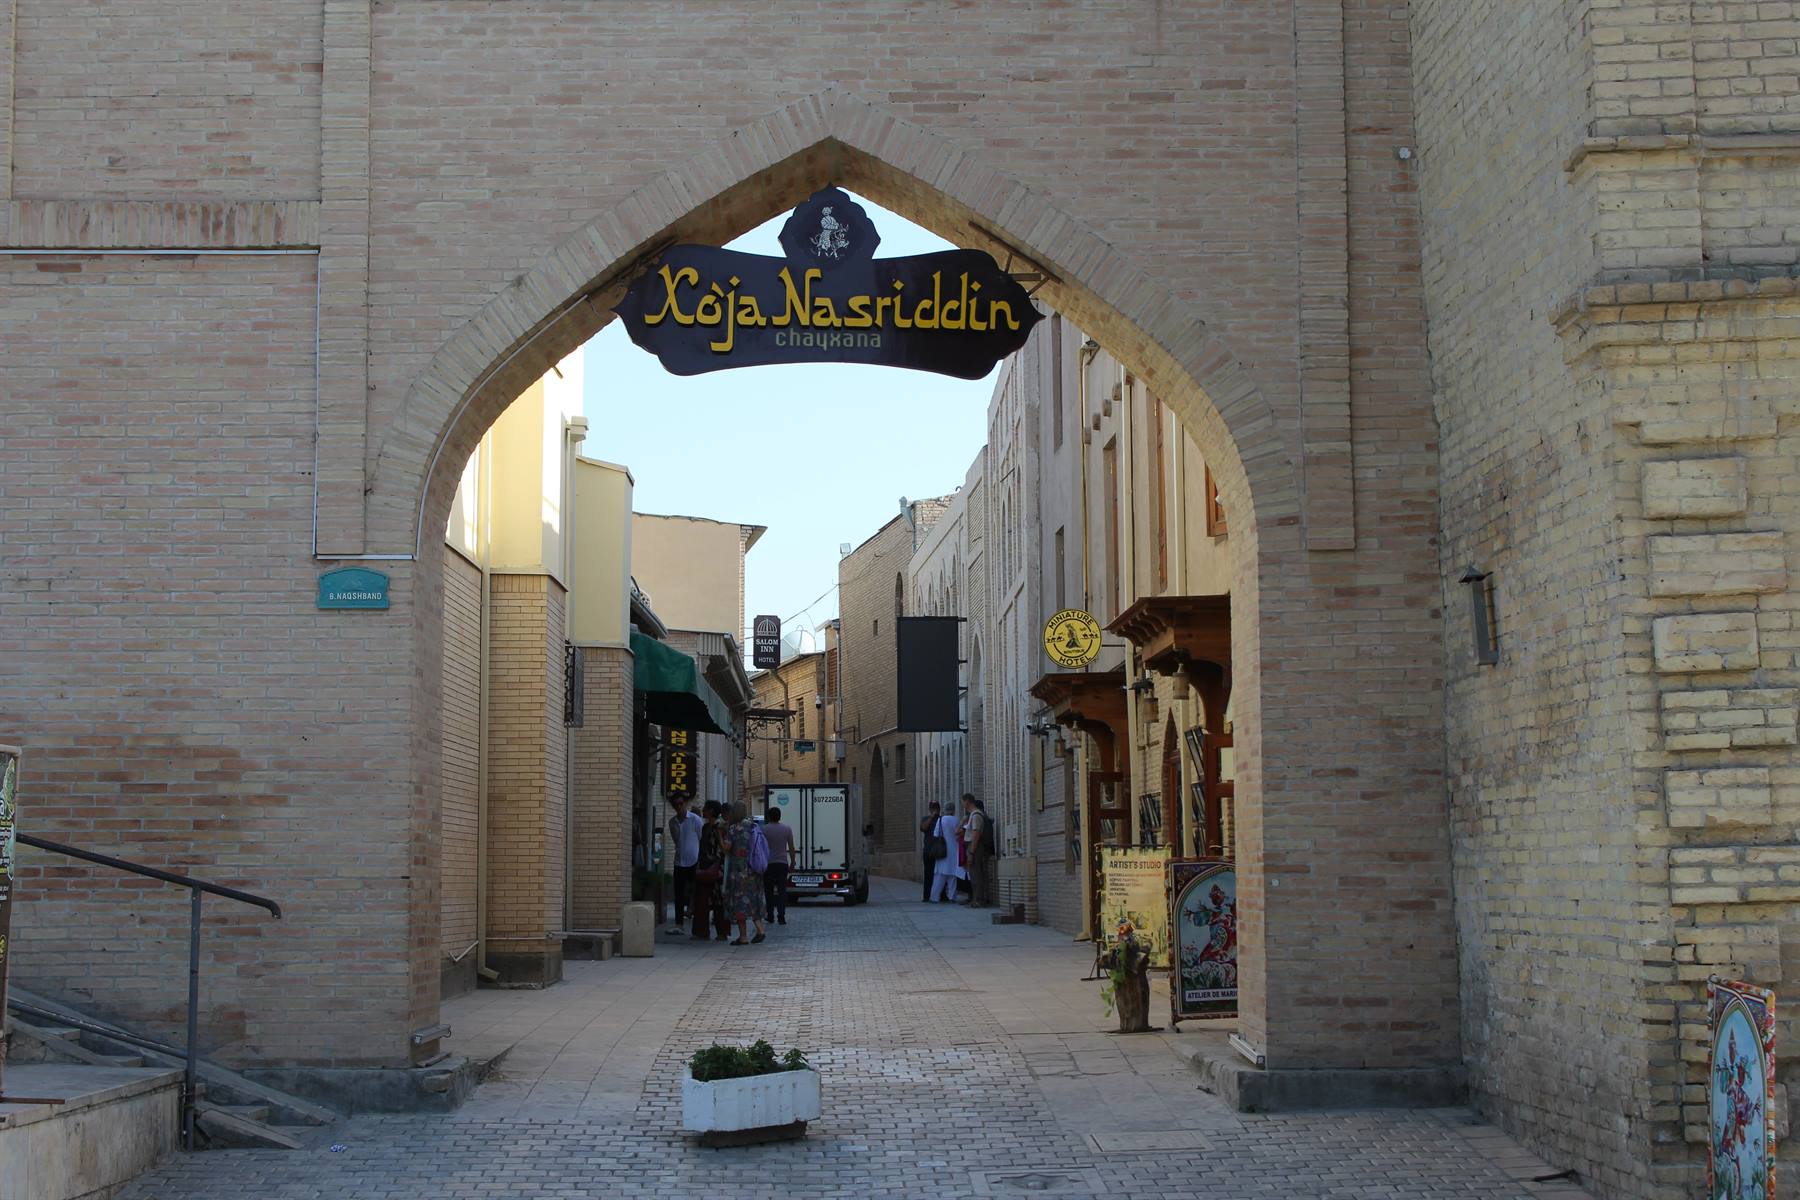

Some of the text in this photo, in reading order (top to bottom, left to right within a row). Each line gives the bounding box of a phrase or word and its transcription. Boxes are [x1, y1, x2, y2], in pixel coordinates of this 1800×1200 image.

[772, 266, 1020, 331] Nasriddin
[775, 330, 881, 350] chayxana
[1048, 611, 1094, 629] MINIATURE
[1059, 655, 1092, 665] HOTEL
[1109, 861, 1161, 869] ARTIST'S STUDIO
[1187, 991, 1210, 999] ATELIER
